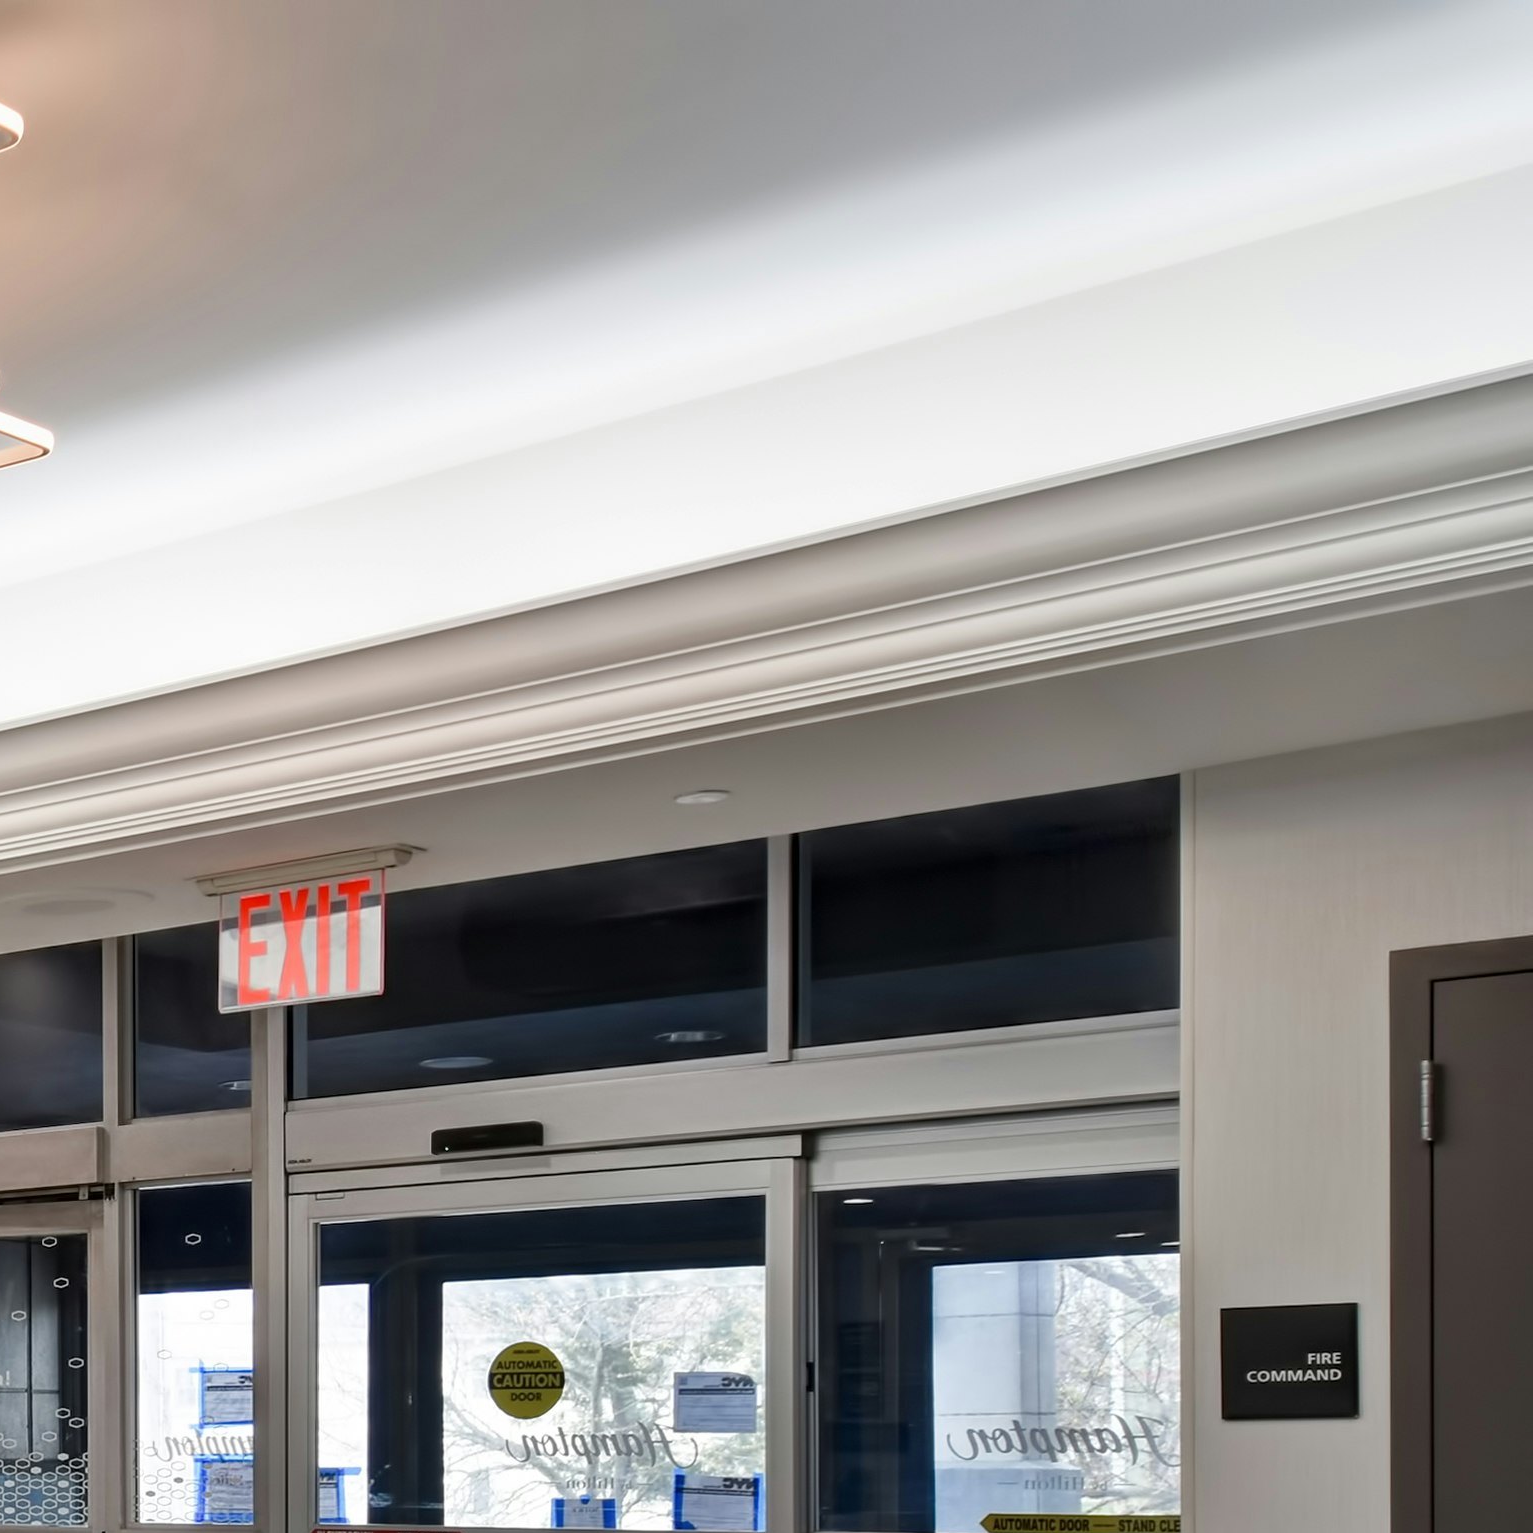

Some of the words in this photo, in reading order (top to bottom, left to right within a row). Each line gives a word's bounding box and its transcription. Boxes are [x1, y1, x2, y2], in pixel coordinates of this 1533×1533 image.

[238, 876, 372, 1006] EXIT
[496, 1360, 558, 1370] AUTOMATIC
[1307, 1352, 1342, 1365] FIRE
[493, 1374, 560, 1388] CAUTION
[1246, 1368, 1342, 1383] COMMAND
[510, 1392, 542, 1401] DOOR
[993, 1518, 1056, 1531] AUTOMATIC
[1059, 1519, 1090, 1531] DOOR
[1118, 1519, 1156, 1532] STAND
[1159, 1520, 1181, 1533] CLE
